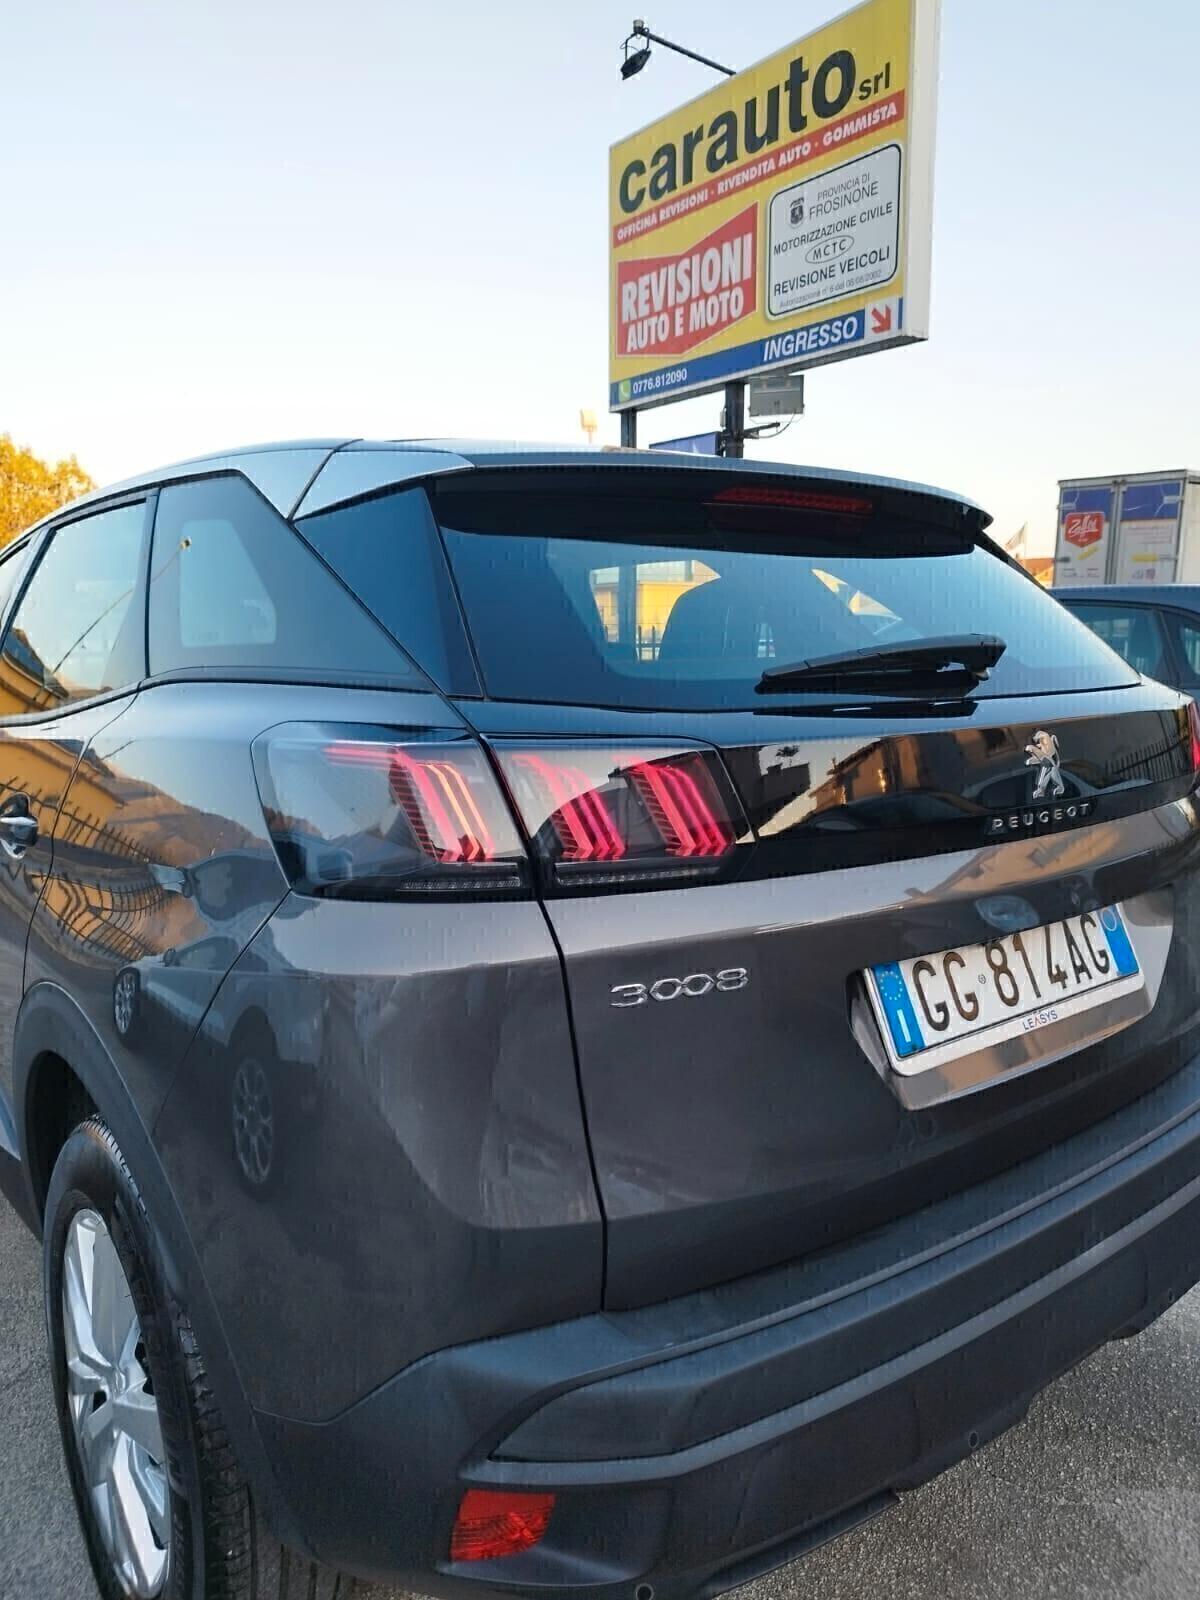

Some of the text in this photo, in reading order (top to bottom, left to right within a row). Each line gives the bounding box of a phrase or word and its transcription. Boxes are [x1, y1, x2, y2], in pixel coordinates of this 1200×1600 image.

[619, 50, 890, 213] carauto srl
[617, 102, 897, 241] OFFICINA REVISIONI RIVENDITA AUTO GOMMISTA
[817, 172, 870, 200] PROVINCIA DI
[809, 181, 879, 219] FROSINONE
[773, 202, 892, 256] MOTORIZZAZIONE CIVILE
[813, 239, 847, 260] MCTC
[622, 233, 752, 324] REVISIONI
[774, 245, 889, 296] REVISIONE VEICOLI
[627, 286, 744, 352] AUTO E MOTO
[763, 316, 858, 362] INGRESSO
[632, 368, 687, 394] 0776.812090
[992, 803, 1089, 831] PEUGEOT
[611, 967, 748, 1007] 3008
[1022, 1010, 1058, 1031] LEASYS
